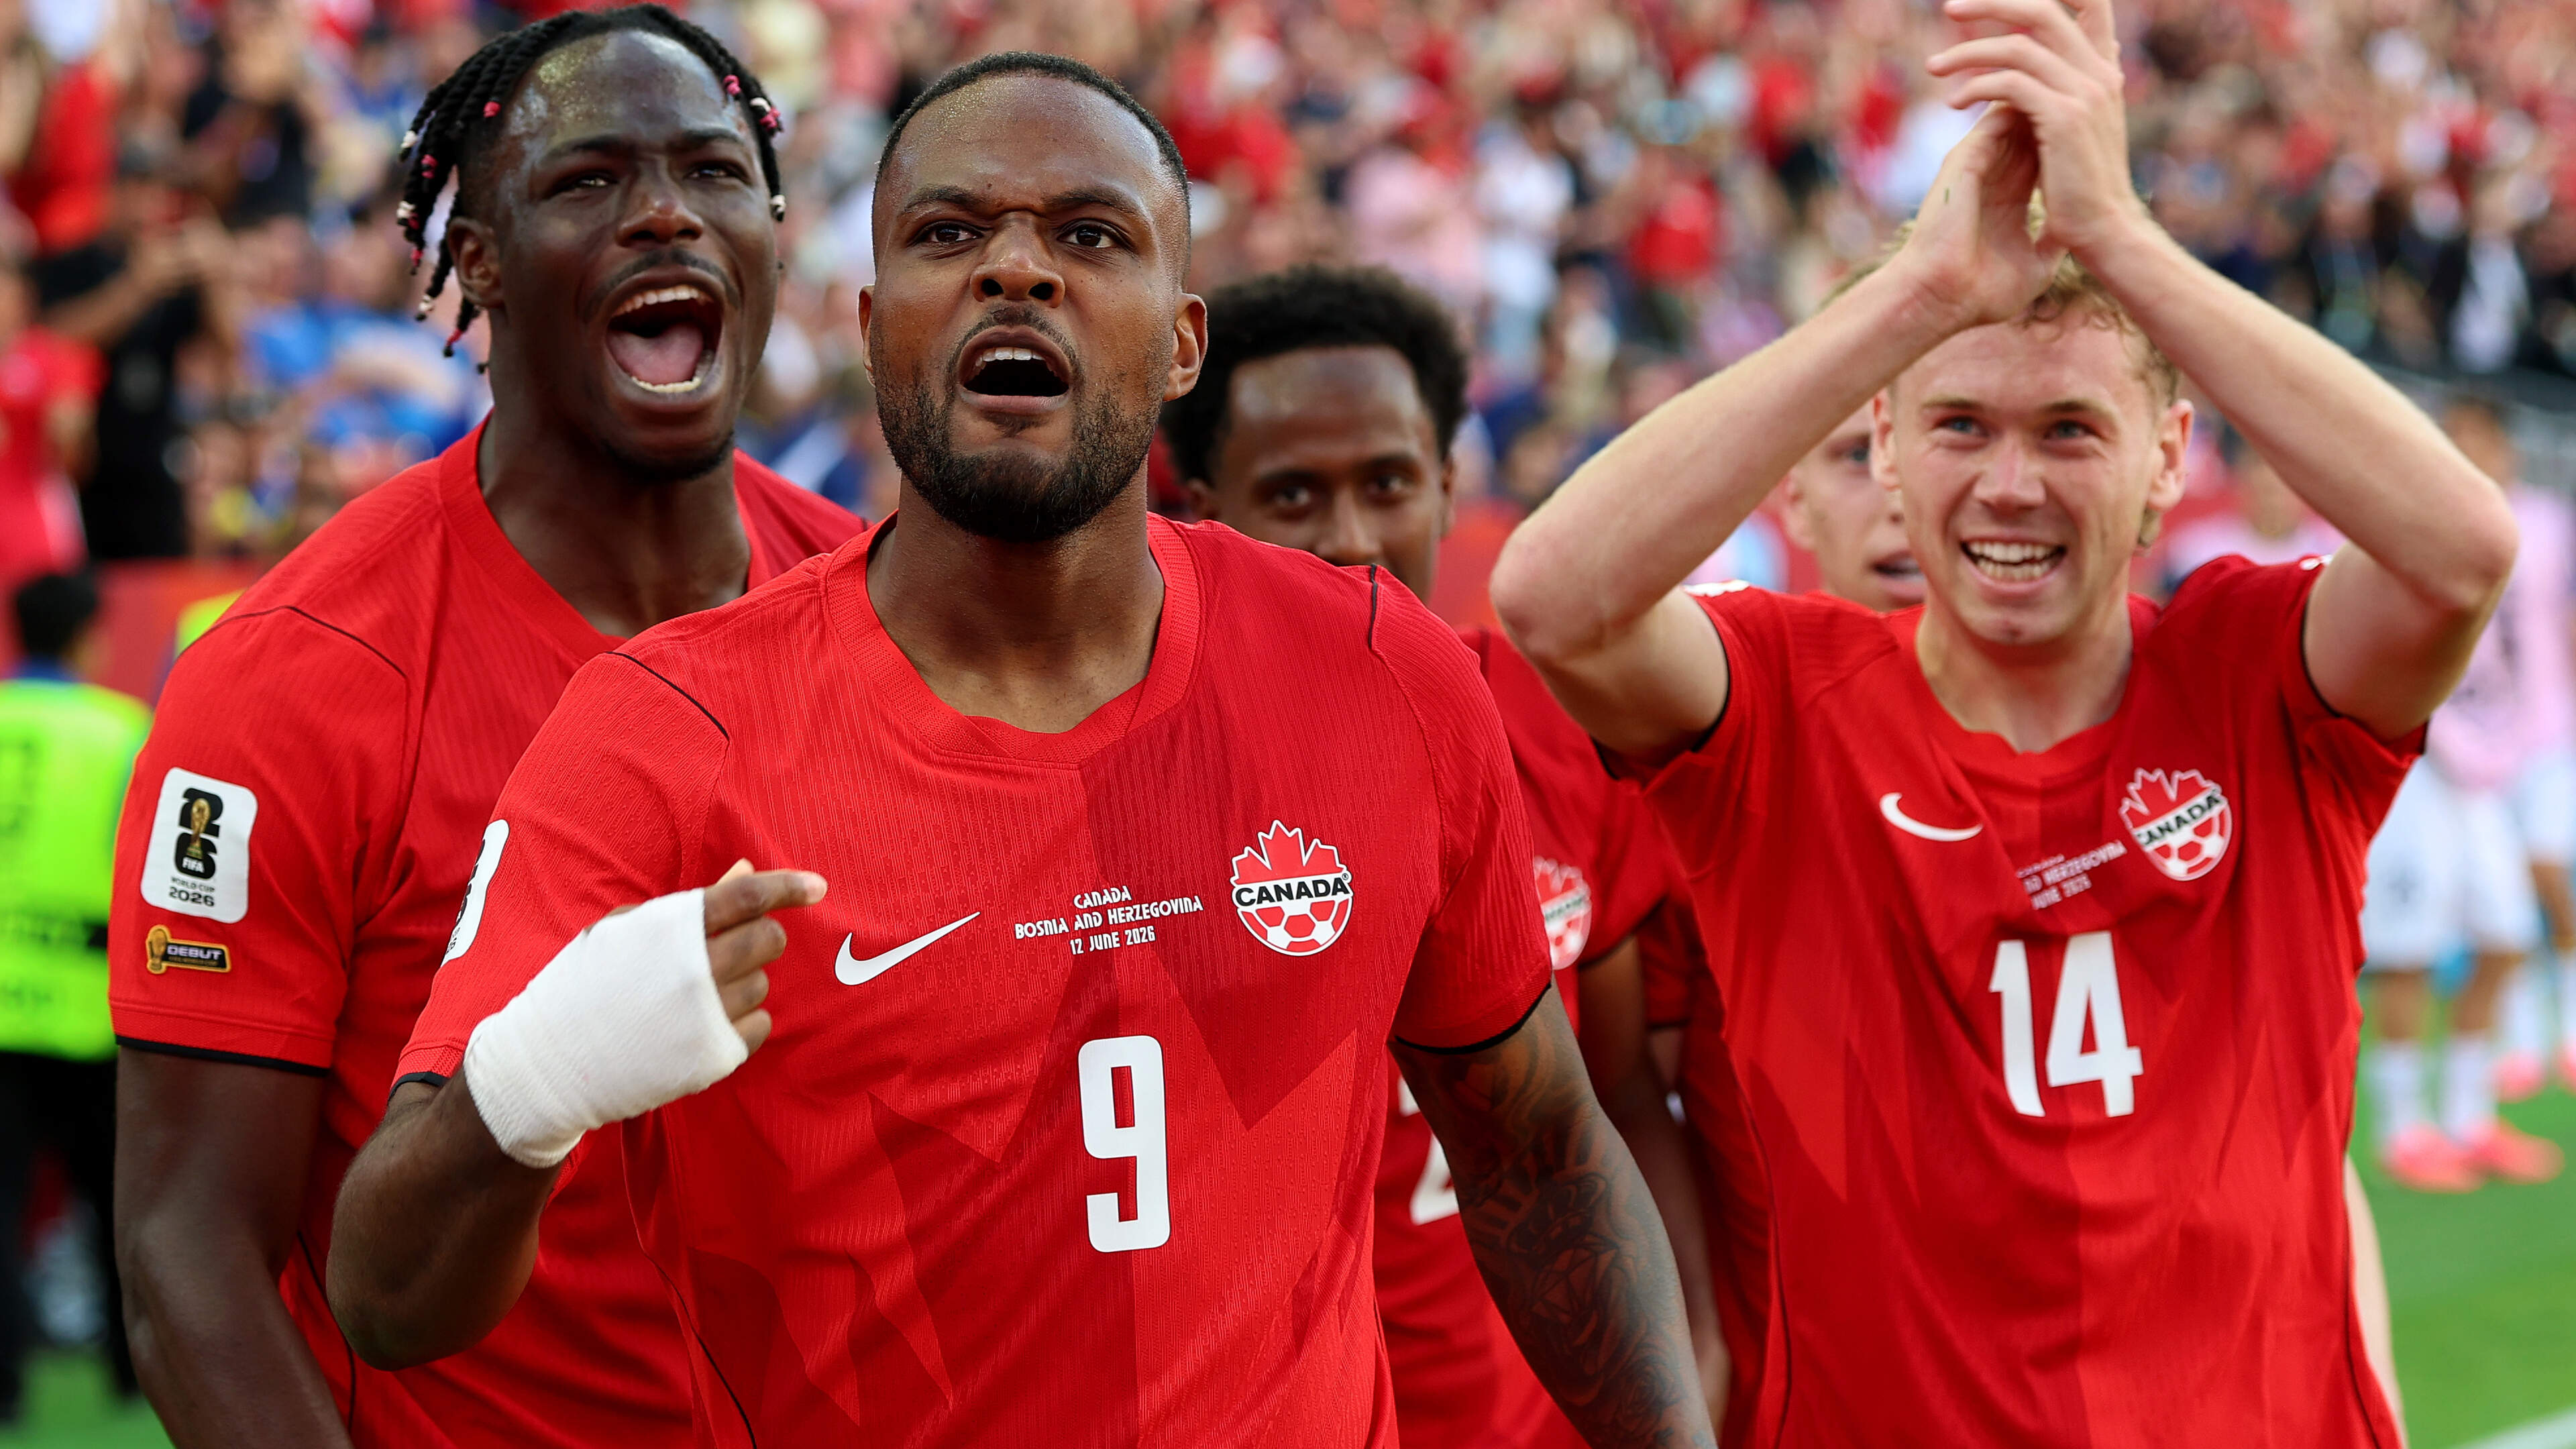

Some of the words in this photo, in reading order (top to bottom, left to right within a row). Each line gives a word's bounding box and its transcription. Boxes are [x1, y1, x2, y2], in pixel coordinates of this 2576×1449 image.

[2137, 795, 2220, 845] CANADA
[182, 857, 205, 873] FIFA
[169, 886, 215, 907] 2026
[1074, 885, 1132, 908] CANADA
[1236, 877, 1350, 906] CANADA
[1014, 917, 1069, 939] BOSNIA
[1074, 911, 1103, 930] AND
[1107, 896, 1204, 925] HERZEGOVINA
[167, 944, 222, 960] DEBUT
[1070, 938, 1084, 955] 12
[1089, 932, 1120, 952] JUNE
[1125, 925, 1156, 946] 2026
[1988, 930, 2144, 1118] 14
[1077, 1034, 1171, 1252] 9
